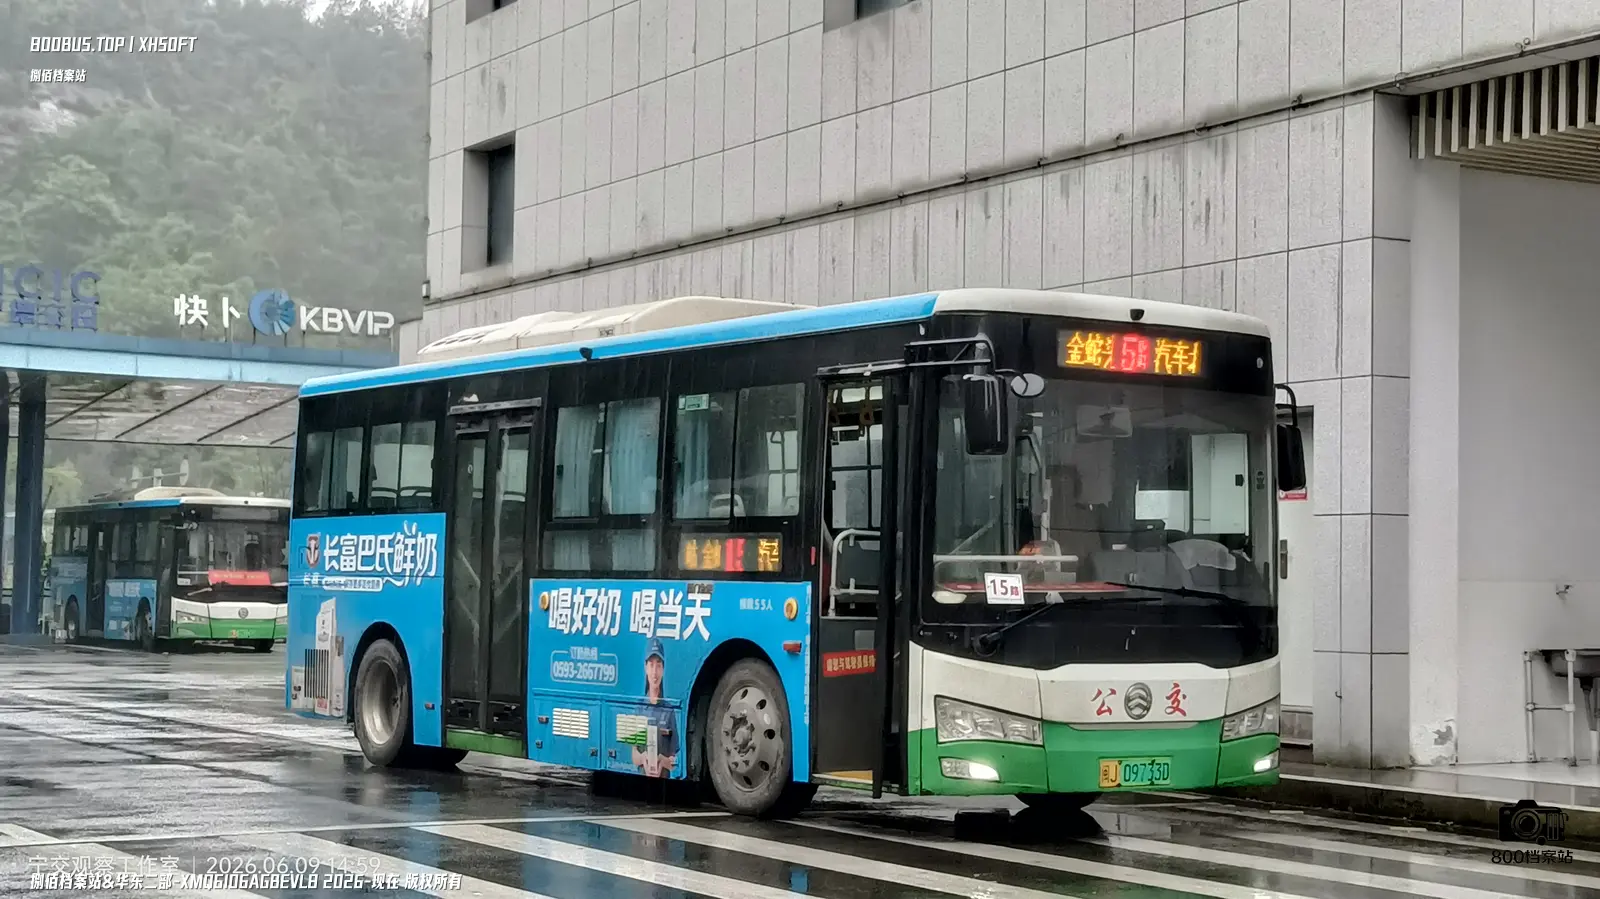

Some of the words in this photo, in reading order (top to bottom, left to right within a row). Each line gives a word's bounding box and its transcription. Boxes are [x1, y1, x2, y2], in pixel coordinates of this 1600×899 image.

[300, 305, 395, 336] KBVIP
[324, 521, 438, 587] 长富巴氏鲜奶
[548, 587, 622, 637] 喝好奶
[629, 585, 712, 642] 喝当天
[552, 660, 616, 682] 0593-2667799
